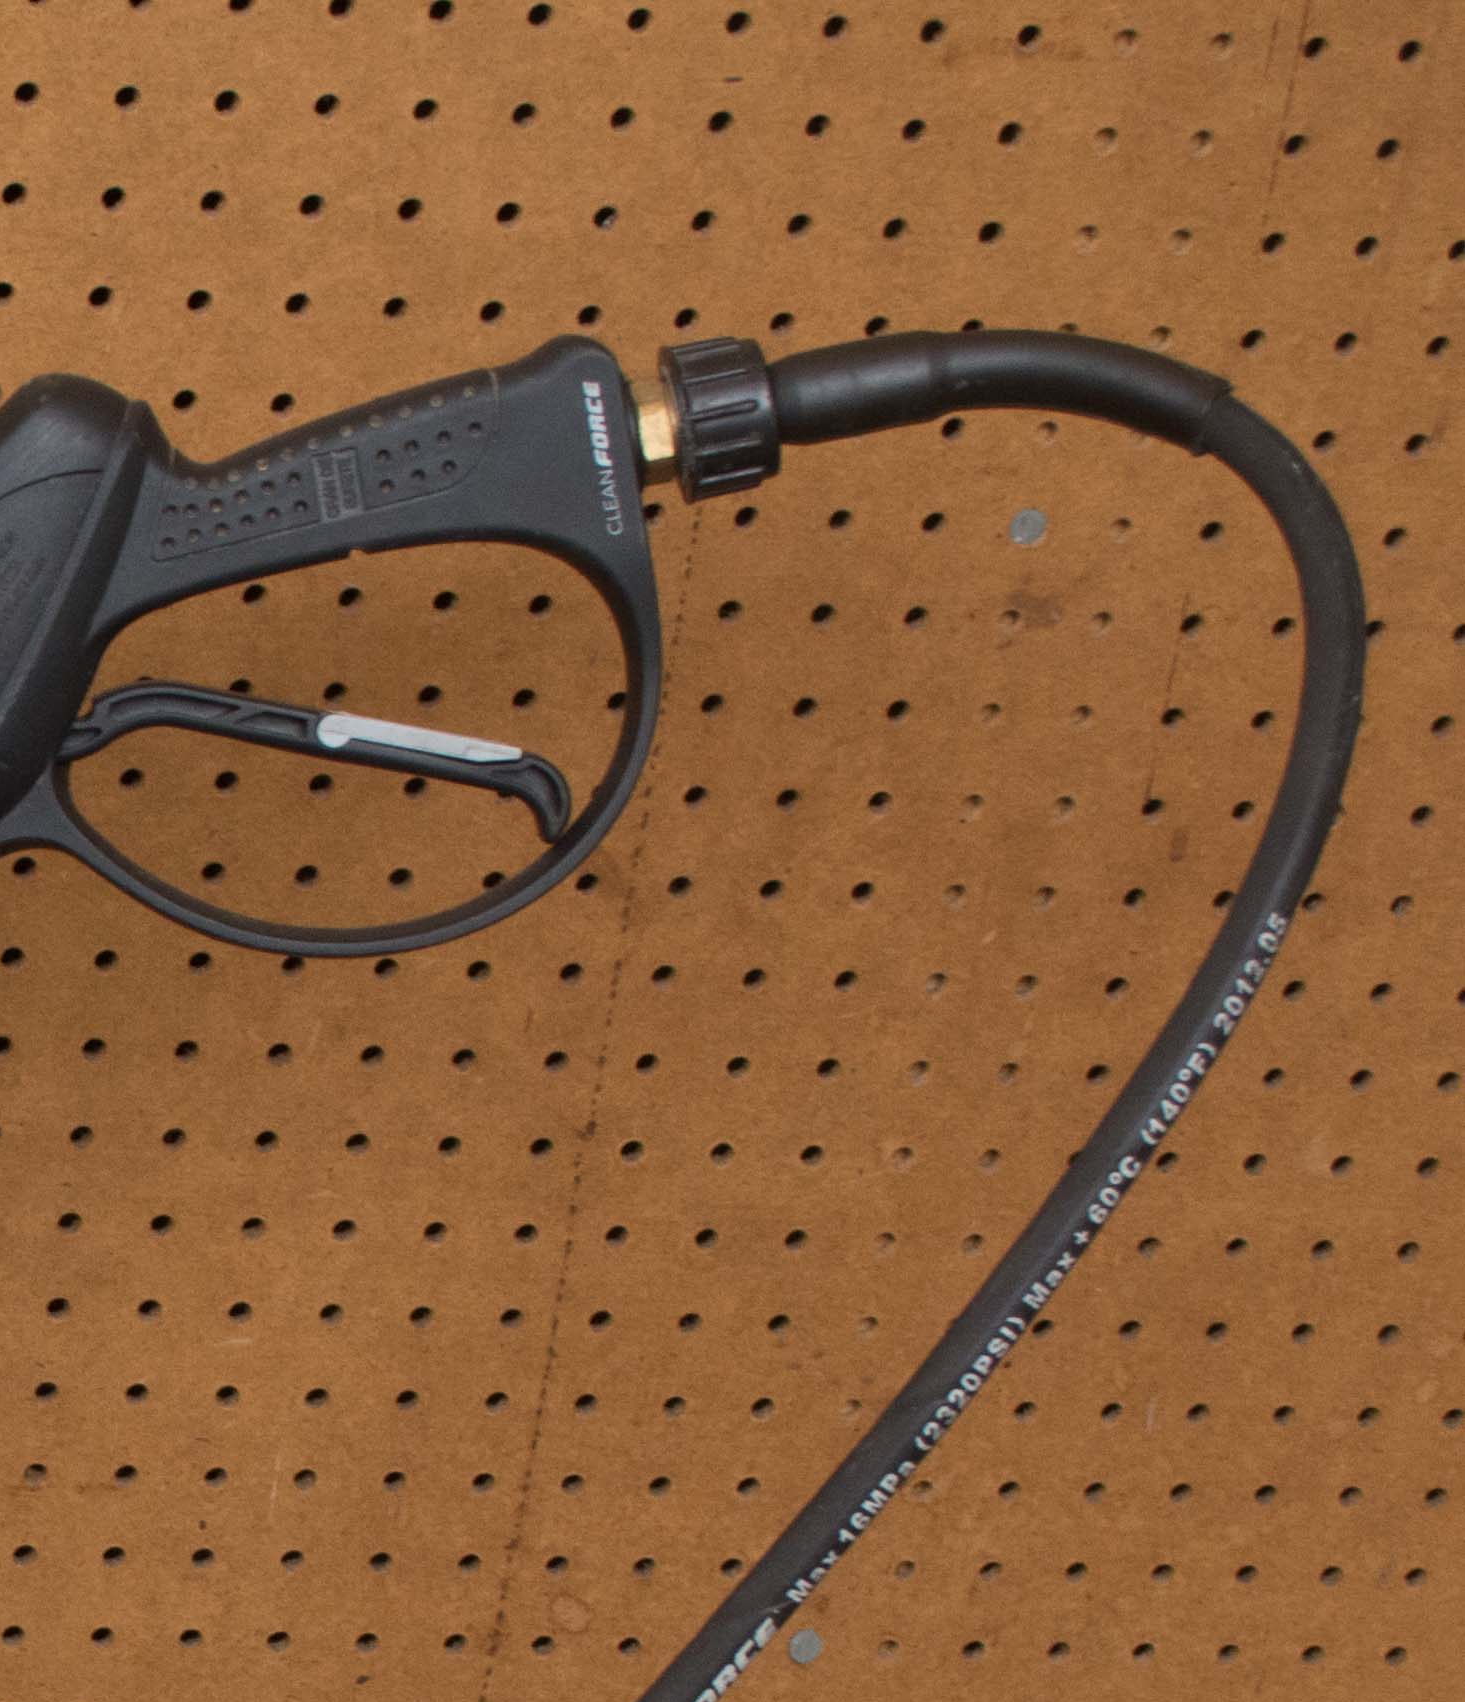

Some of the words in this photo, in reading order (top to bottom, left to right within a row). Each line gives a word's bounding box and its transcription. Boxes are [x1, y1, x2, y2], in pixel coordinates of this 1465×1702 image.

[785, 1550, 839, 1604] Max
[914, 1313, 1027, 1455] (2320PSI)
[1023, 1251, 1076, 1311] Max
